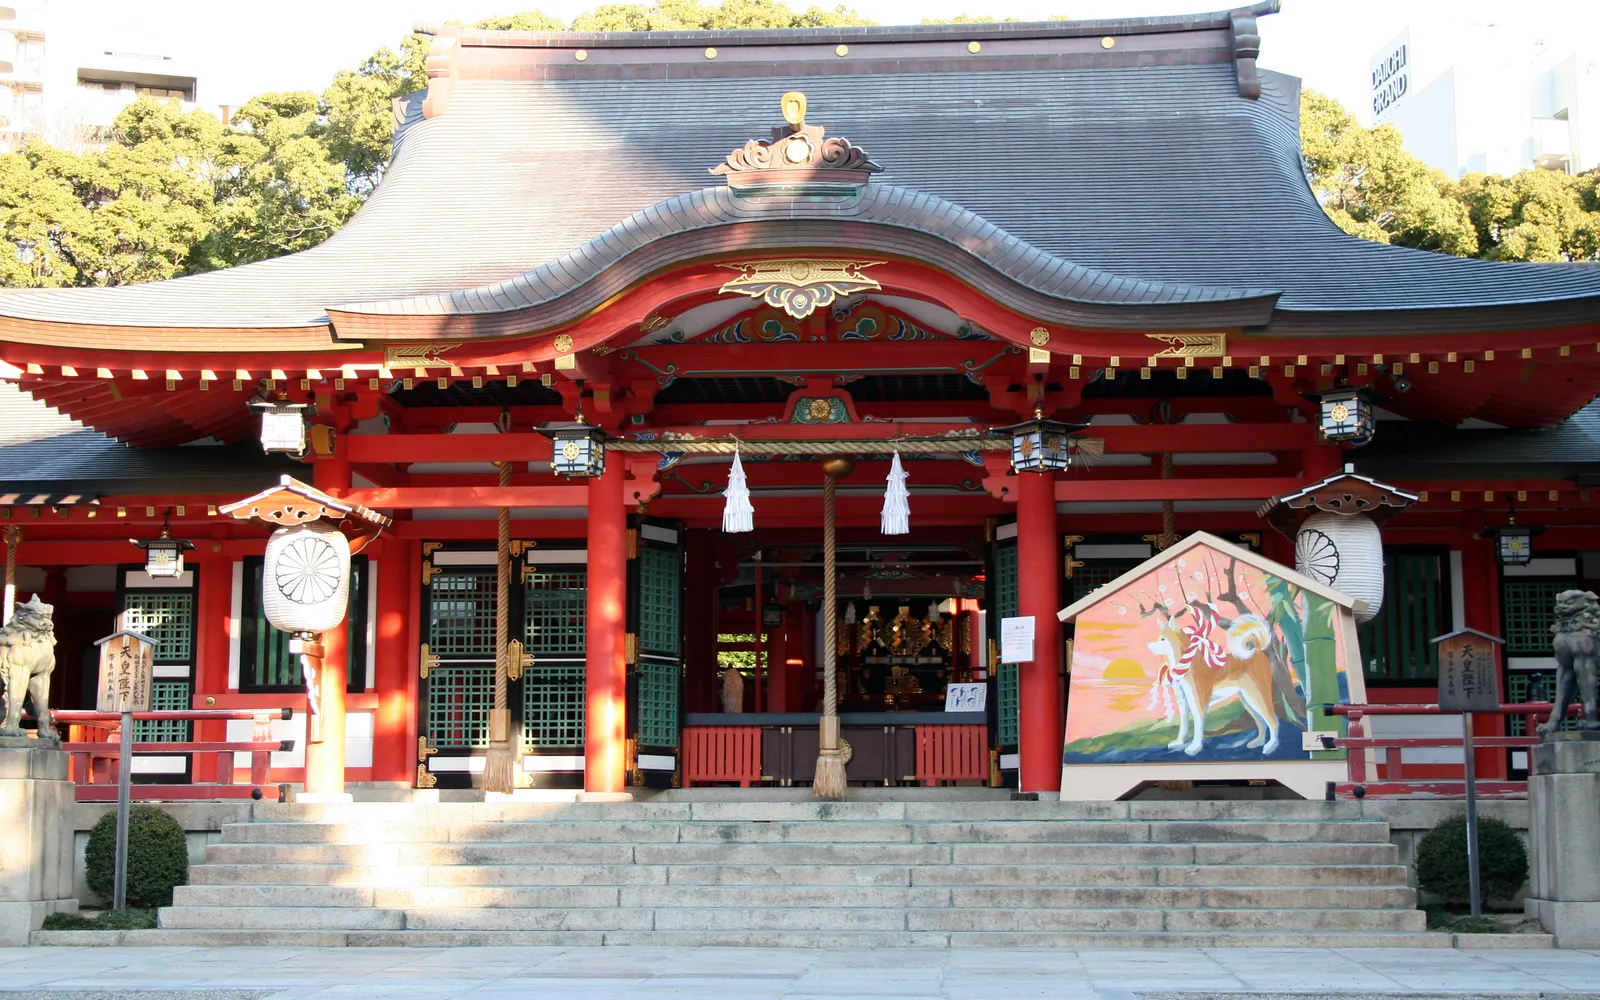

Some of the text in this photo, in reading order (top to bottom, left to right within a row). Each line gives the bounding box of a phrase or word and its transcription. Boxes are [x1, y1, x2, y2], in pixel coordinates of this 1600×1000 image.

[1371, 44, 1406, 90] DAIICHI
[1371, 73, 1407, 115] GRAND
[118, 645, 132, 702] 天皇陛下
[1461, 644, 1475, 699] 天皇陛下
